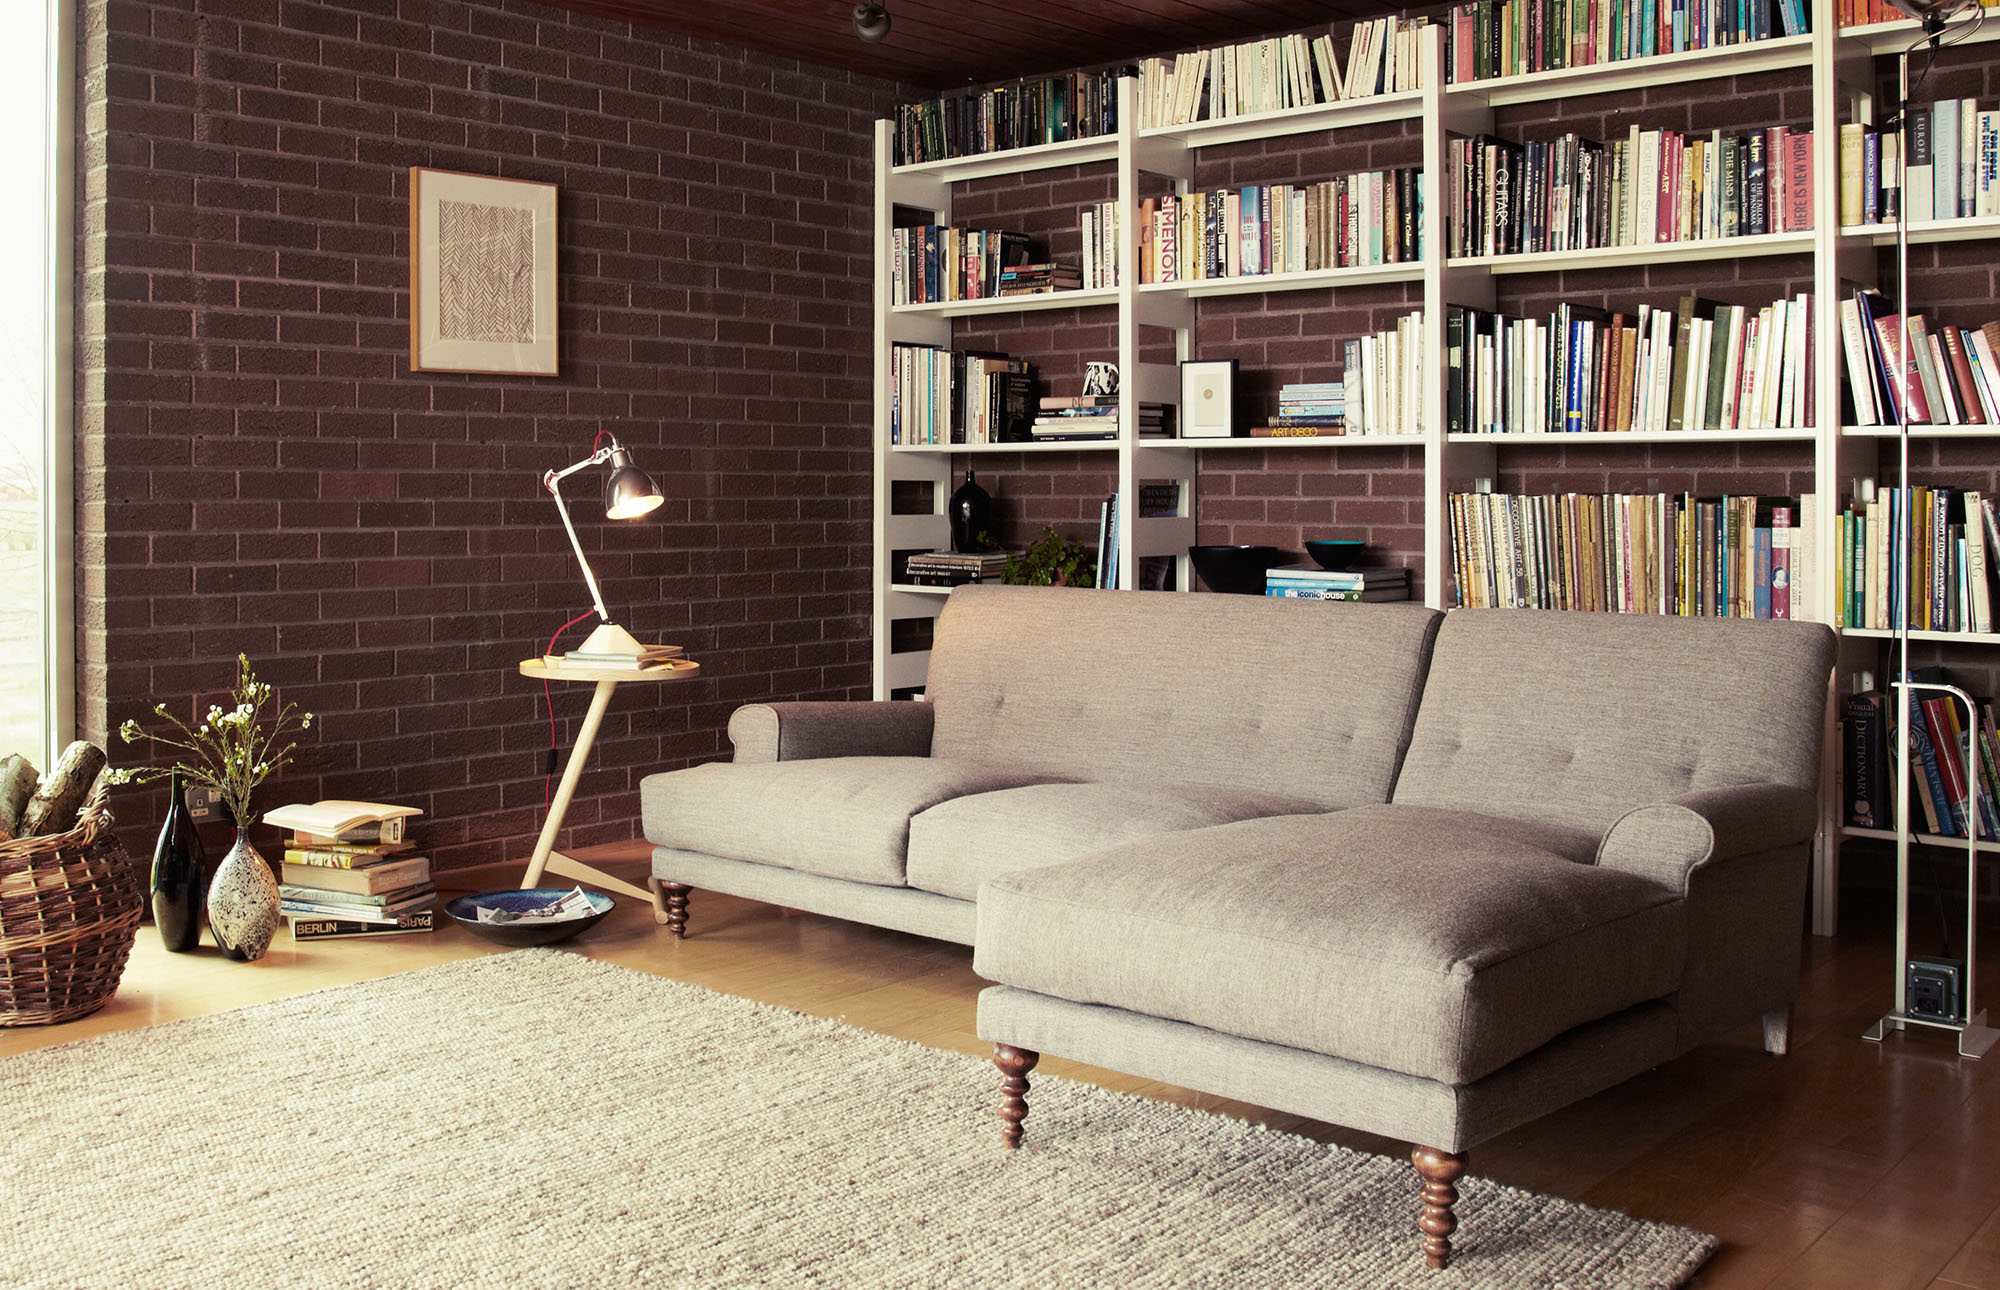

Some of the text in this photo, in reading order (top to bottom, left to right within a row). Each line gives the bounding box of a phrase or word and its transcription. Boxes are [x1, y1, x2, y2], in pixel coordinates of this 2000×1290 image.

[1917, 117, 1925, 160] EUROPE
[1982, 116, 1990, 132] THE
[1982, 135, 1990, 163] RIGHT
[1989, 129, 1998, 180] TOM WOLFE
[1726, 150, 1734, 196] THE MIND
[1750, 183, 1756, 191] OF
[1793, 136, 1807, 226] HERE IS NEW YORK
[1218, 192, 1226, 234] ELMORE LEONARD
[1495, 168, 1509, 227] GUITARS
[1639, 200, 1651, 233] Snaps
[1162, 195, 1174, 283] SIMENON
[1348, 213, 1358, 256] THOMPSON
[1272, 427, 1318, 437] ART DECO
[1467, 500, 1478, 545] DECORATIVE
[1511, 500, 1520, 546] DECORATIVE
[1471, 547, 1479, 562] ART
[1970, 544, 1984, 578] DOG
[296, 922, 337, 935] BERLIN
[400, 916, 431, 928] PARIS
